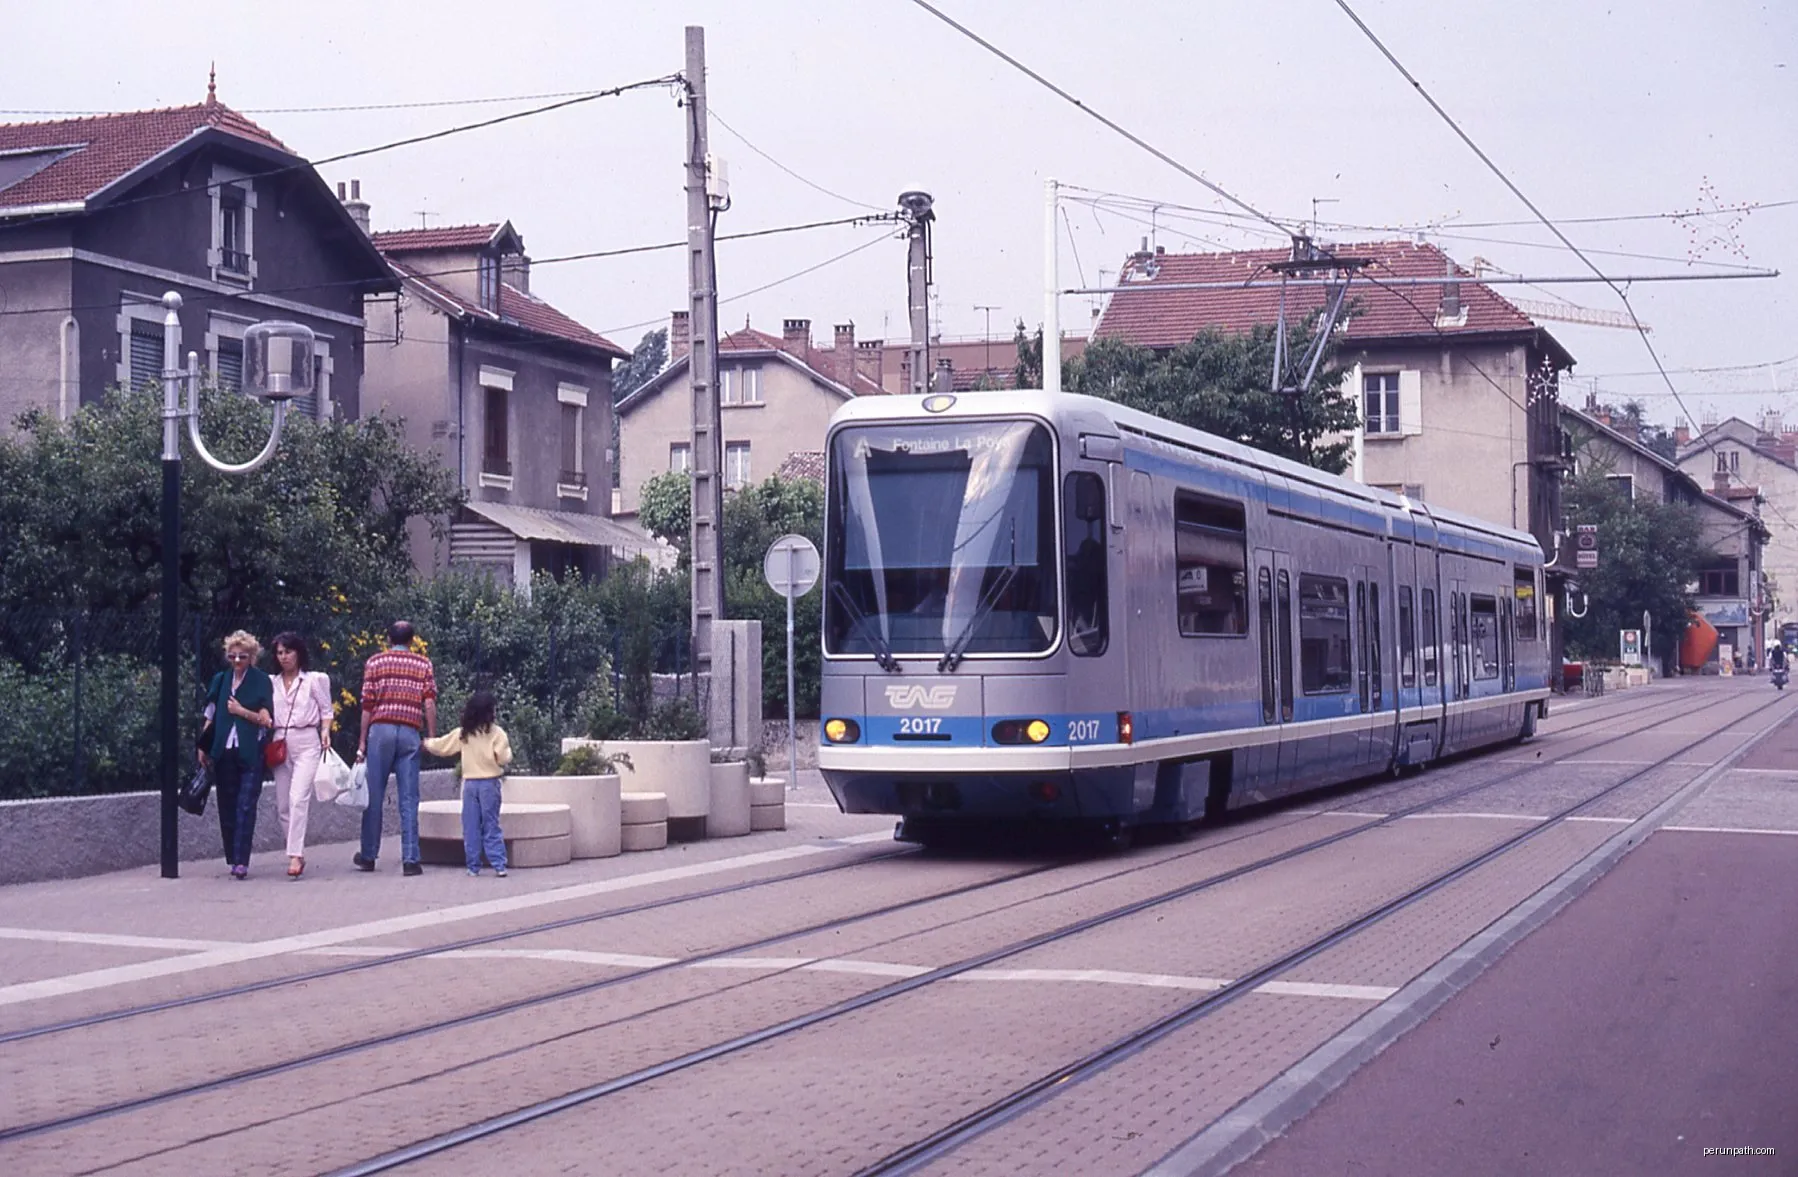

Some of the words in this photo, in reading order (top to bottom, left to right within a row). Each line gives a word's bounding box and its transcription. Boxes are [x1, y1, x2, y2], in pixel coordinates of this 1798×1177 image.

[853, 436, 873, 459] A
[893, 438, 950, 452] Fontaine
[955, 437, 971, 450] La
[900, 718, 942, 734] 2017
[1068, 720, 1100, 741] 2017
